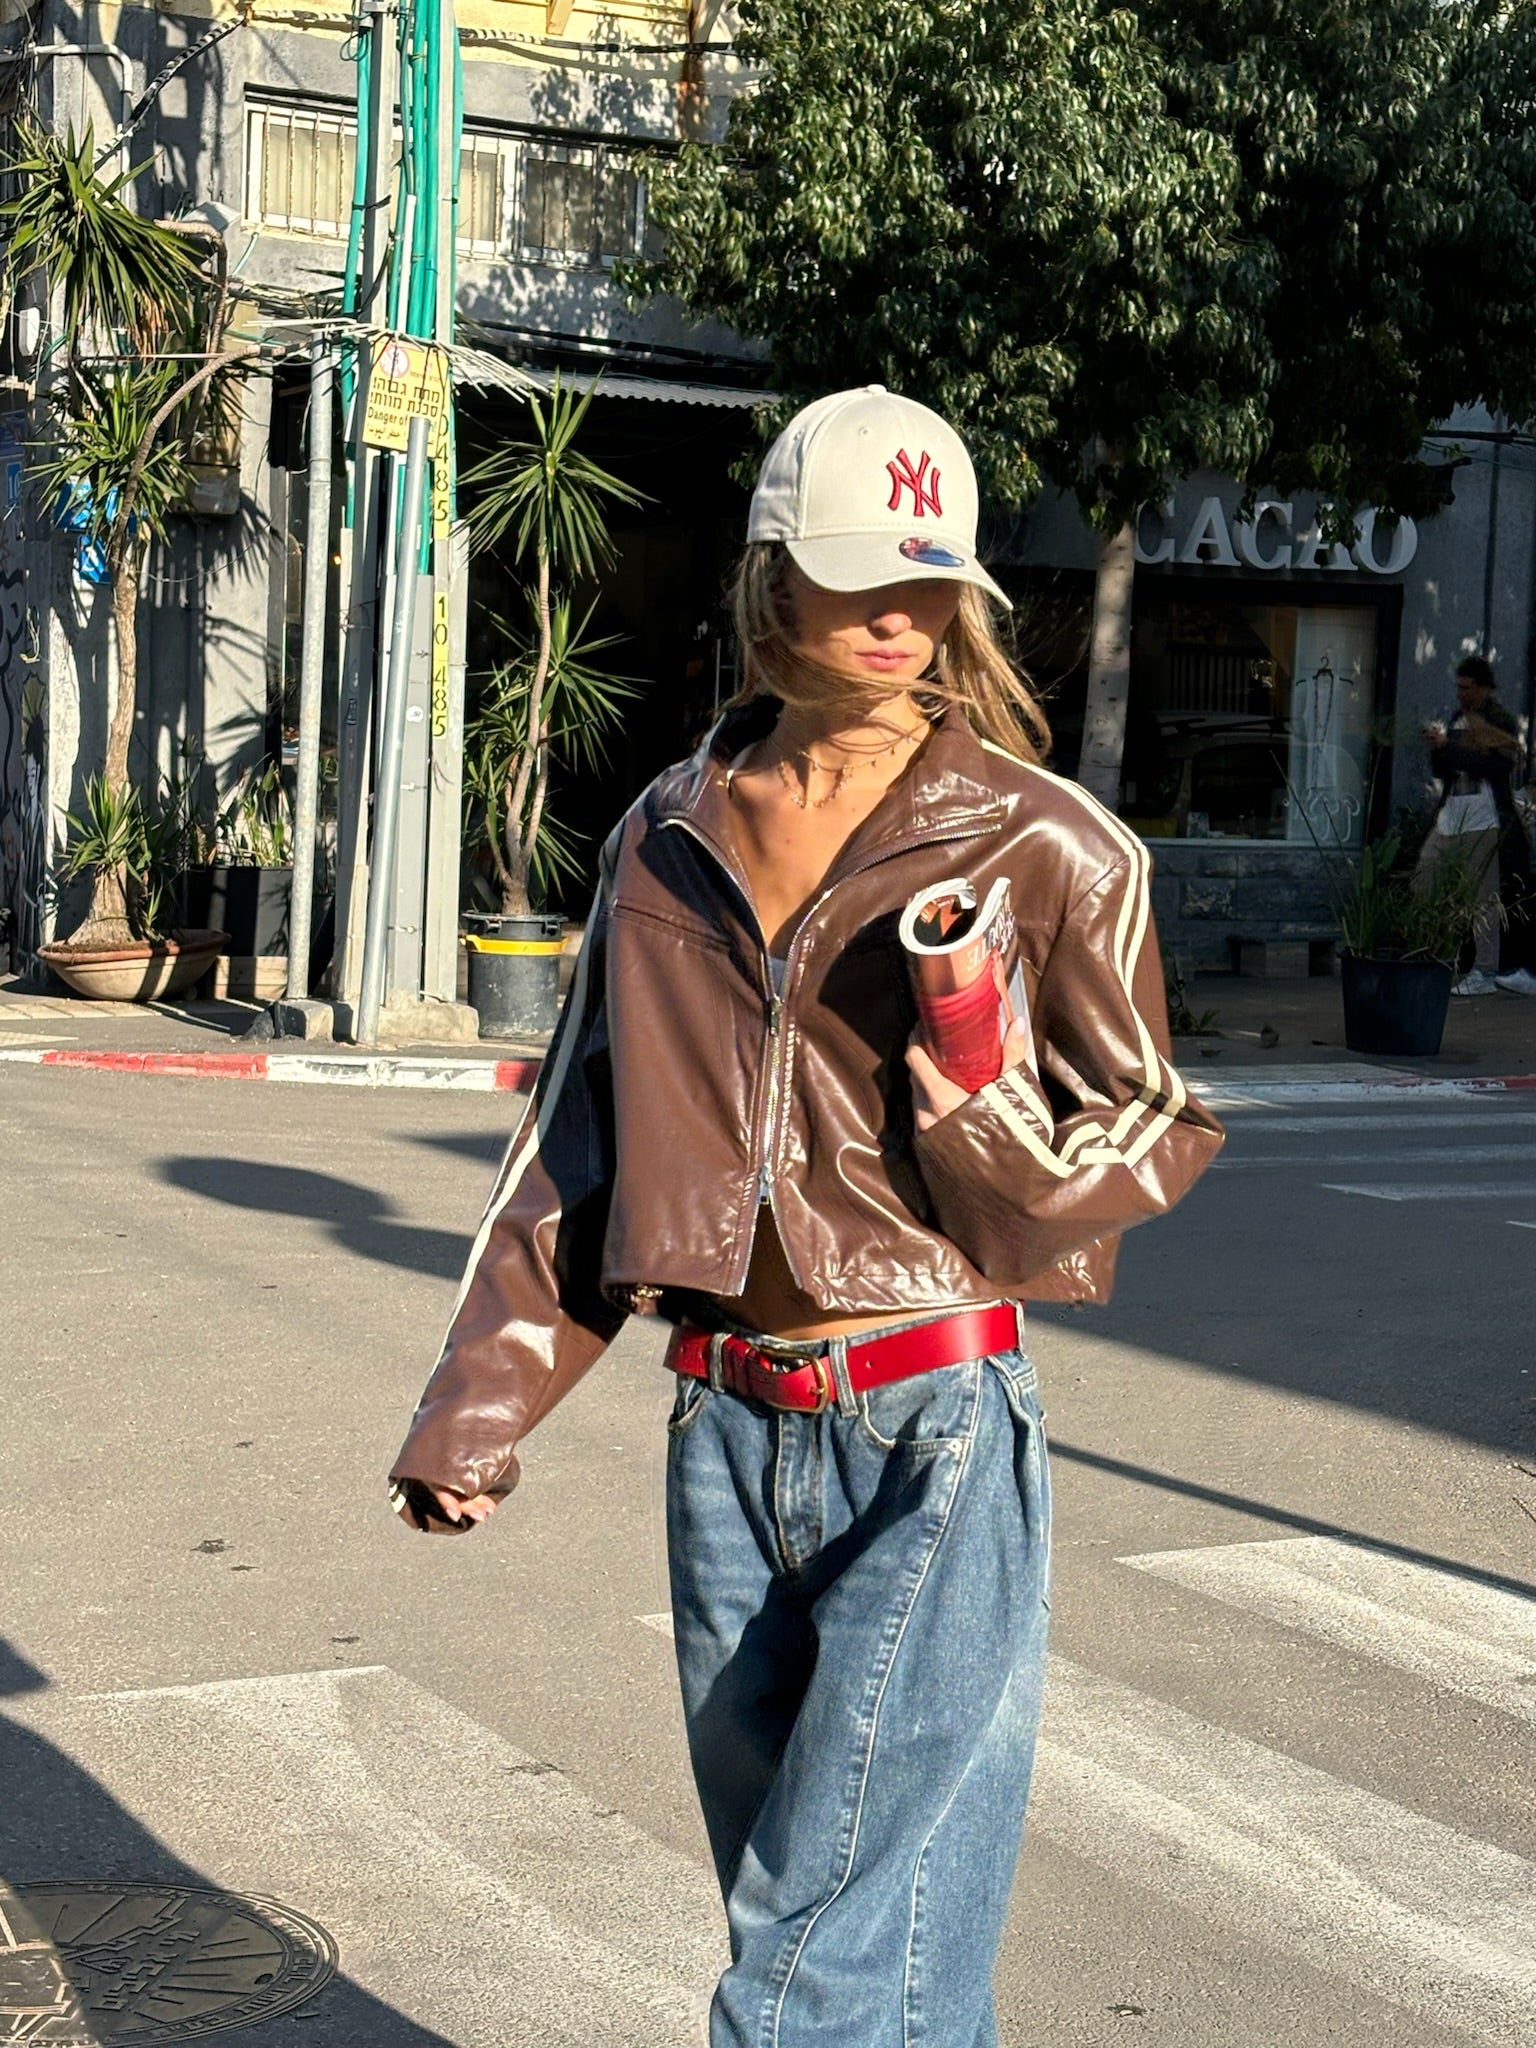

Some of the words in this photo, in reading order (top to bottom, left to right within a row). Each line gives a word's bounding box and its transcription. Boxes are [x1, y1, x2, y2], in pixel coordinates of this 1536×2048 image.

[368, 406, 398, 425] Danger
[399, 414, 409, 426] of
[407, 400, 438, 417] סכנת
[885, 447, 943, 518] NY
[1134, 496, 1418, 575] CACAO
[159, 1930, 202, 1946] מי
[90, 1952, 180, 2012] אביבים
